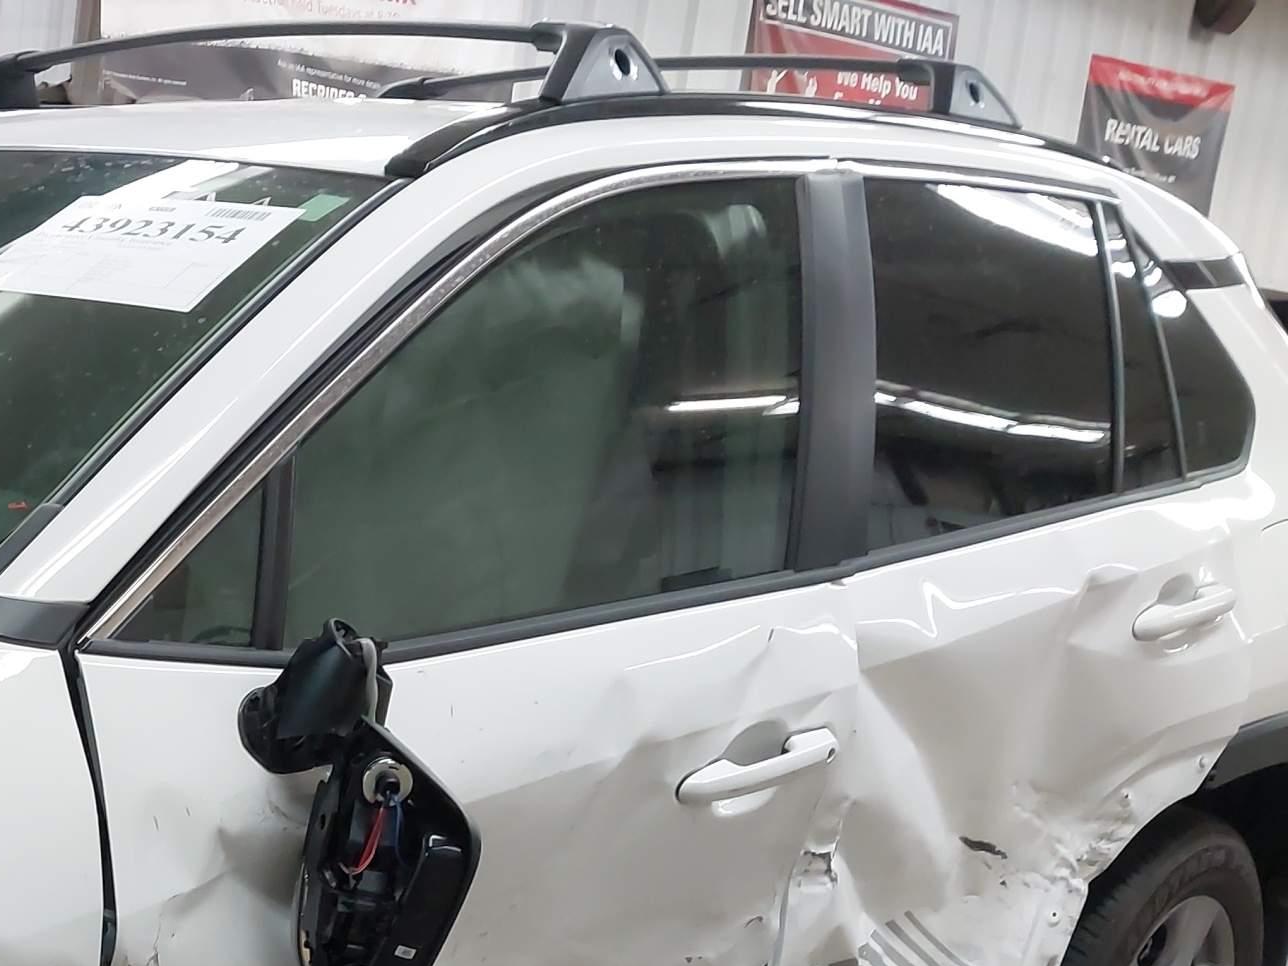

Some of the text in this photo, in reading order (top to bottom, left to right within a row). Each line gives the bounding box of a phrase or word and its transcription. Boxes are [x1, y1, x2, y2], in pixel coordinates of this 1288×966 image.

[810, 0, 873, 38] SMART
[874, 13, 915, 49] WITH
[916, 23, 944, 57] IAA
[837, 71, 858, 88] We
[861, 73, 892, 99] Help
[895, 77, 919, 101] You
[1104, 118, 1202, 161] RENTAL CARS
[61, 216, 247, 245] 43923154
